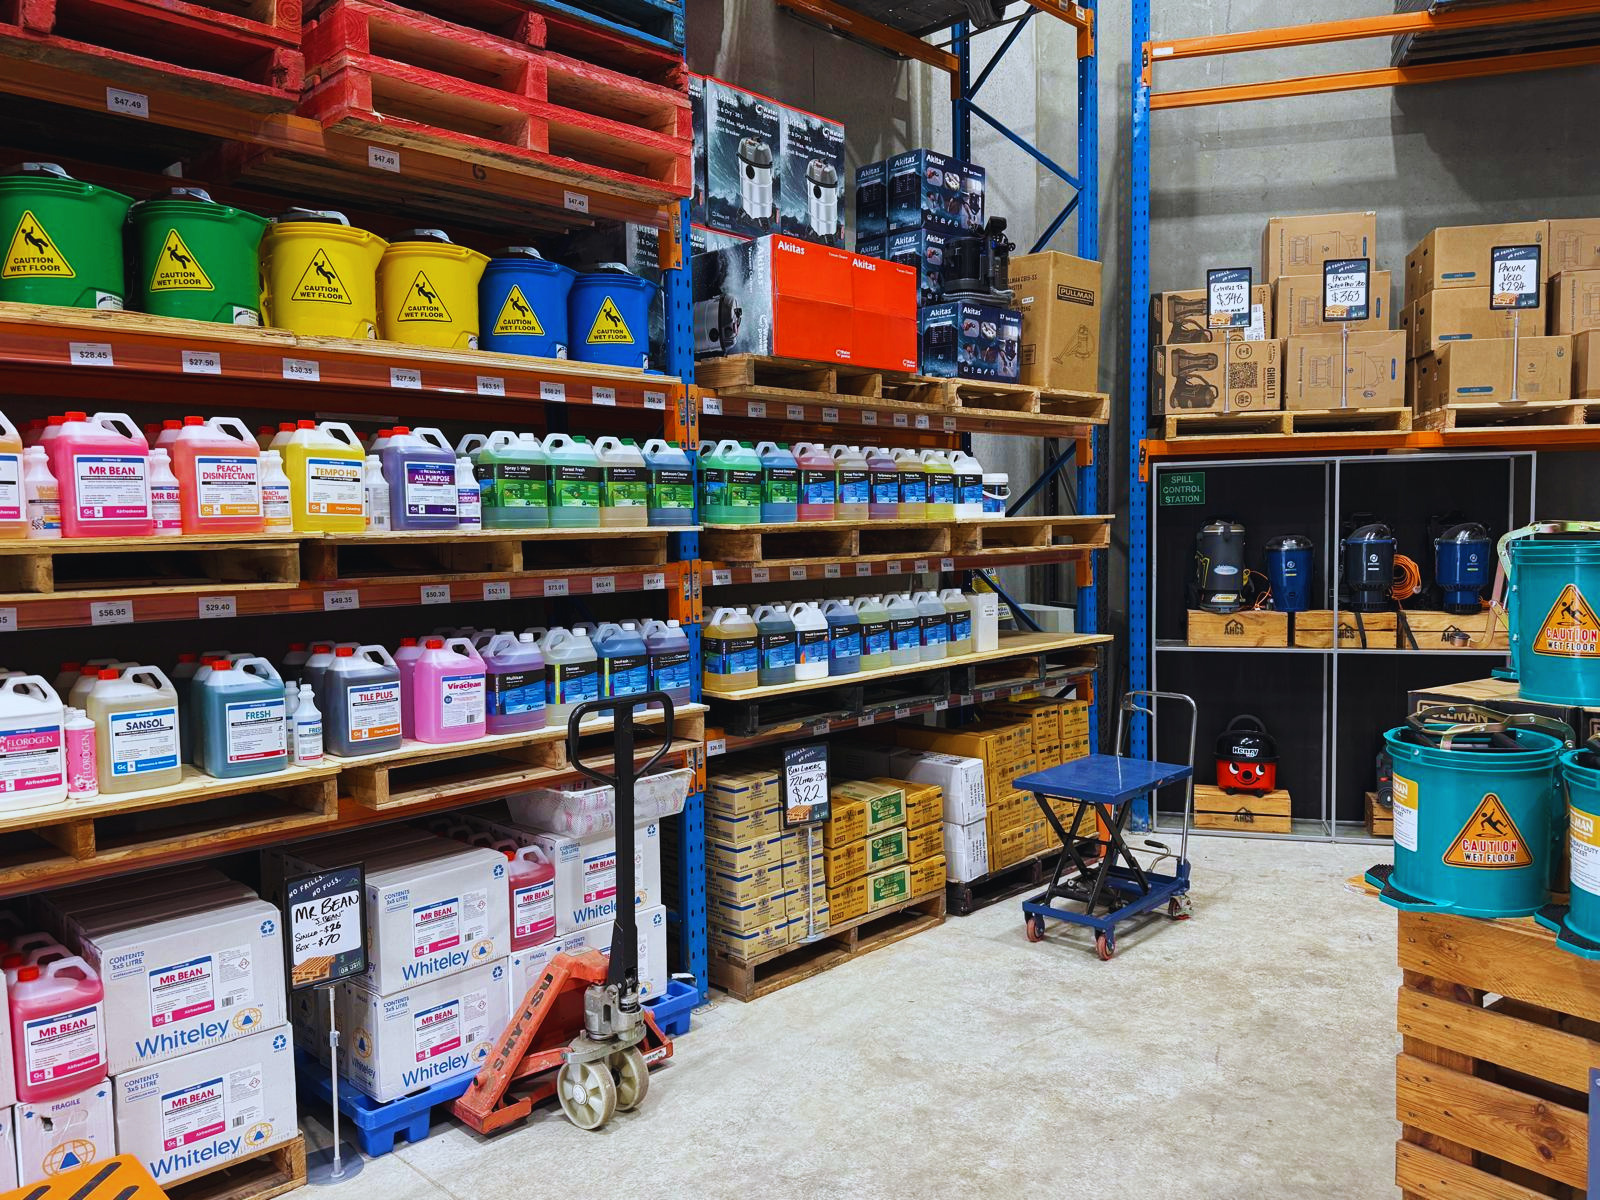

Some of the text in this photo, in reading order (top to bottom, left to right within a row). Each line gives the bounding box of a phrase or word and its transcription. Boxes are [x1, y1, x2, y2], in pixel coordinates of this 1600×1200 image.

[114, 97, 142, 109] $47.49
[894, 154, 916, 167] Akitas
[925, 154, 946, 166] Akitas
[894, 234, 916, 247] Akitas
[926, 233, 946, 245] Akitas
[777, 240, 805, 255] Akitas
[29, 264, 61, 272] FLOOR
[852, 257, 876, 272] Akitas
[304, 285, 338, 293] CAUTION
[1060, 288, 1095, 301] PULLMAN
[318, 292, 343, 300] FLOOR
[1331, 290, 1360, 303] $363
[930, 307, 953, 318] Akitas
[962, 306, 983, 316] Akitas
[79, 350, 108, 359] $28.45
[188, 358, 214, 367] $27.50
[290, 365, 313, 375] $30.35
[395, 373, 417, 383] $27.50
[88, 466, 136, 475] MR BEAN
[216, 464, 242, 473] PEACH
[314, 467, 358, 478] TEMPO HD
[202, 472, 256, 481] DISINFECTANT
[414, 474, 451, 483] ALL PURPOSE
[1171, 475, 1193, 484] SPILL
[1163, 485, 1202, 494] CONTROL
[151, 492, 180, 500] MR BEA
[1165, 495, 1200, 504] STATION
[205, 603, 230, 612] $29.40
[330, 597, 353, 606] $49.35
[98, 608, 127, 617] $56.95
[1546, 627, 1598, 643] CAUTION
[1547, 640, 1595, 652] WET FLOOR
[447, 681, 482, 691] Viraclean
[358, 691, 394, 702] TILE PLUS
[245, 709, 271, 720] FRESH
[125, 718, 165, 731] SANSOL
[7, 735, 53, 747] FLOROGEN
[81, 733, 90, 778] FLOROGEN
[1232, 746, 1259, 758] Henry
[792, 784, 824, 805] $22
[1462, 838, 1518, 854] CAUTION
[600, 859, 615, 868] BEAN
[1464, 853, 1516, 863] WET FLOOR
[312, 887, 321, 897] NO
[384, 889, 410, 900] CONTENTS
[522, 889, 551, 902] MR BEAN
[320, 894, 360, 916] BEAN
[420, 907, 452, 921] MR BEAN
[109, 950, 145, 966] CONTENTS
[111, 957, 143, 970] 3x5 LITRE
[402, 949, 471, 982] Whiteley
[159, 967, 203, 985] MR BEAN
[421, 1009, 453, 1026] MR BEAN
[39, 1018, 88, 1039] MR BEAN
[135, 1018, 230, 1058] Whiteley
[402, 1052, 470, 1088] Whiteley
[124, 1072, 160, 1088] CONTENTS
[127, 1079, 157, 1094] 3x5 LITRE
[171, 1088, 215, 1109] MR BEAN
[51, 1098, 81, 1112] FRAGILE
[149, 1135, 243, 1179] Whiteley
